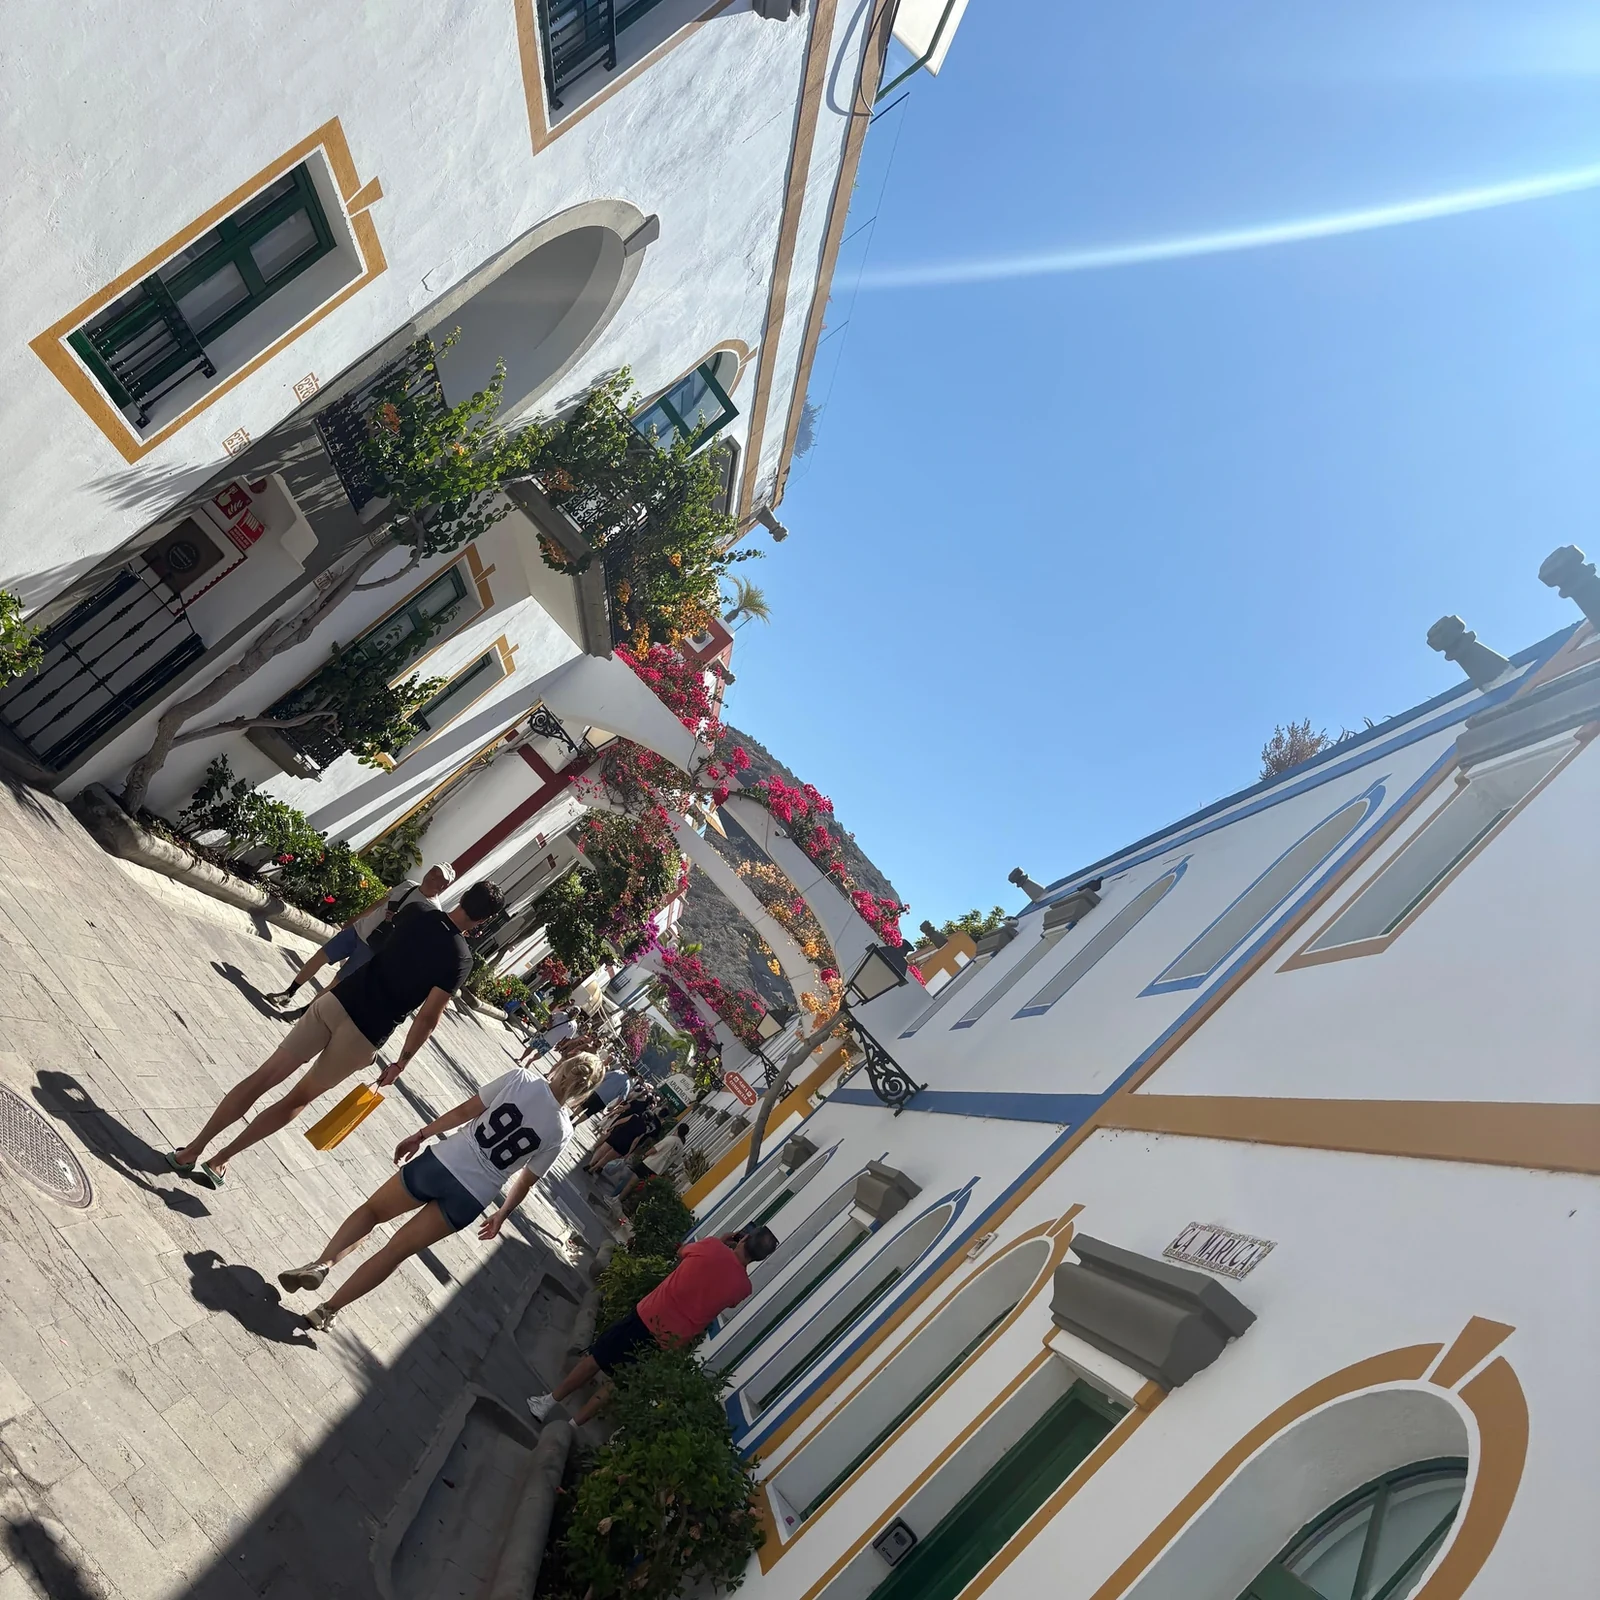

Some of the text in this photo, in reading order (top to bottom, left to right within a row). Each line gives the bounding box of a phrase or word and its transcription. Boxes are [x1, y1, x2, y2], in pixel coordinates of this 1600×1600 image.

[474, 1102, 541, 1170] 98
[1173, 1228, 1262, 1271] CA MARUCA
